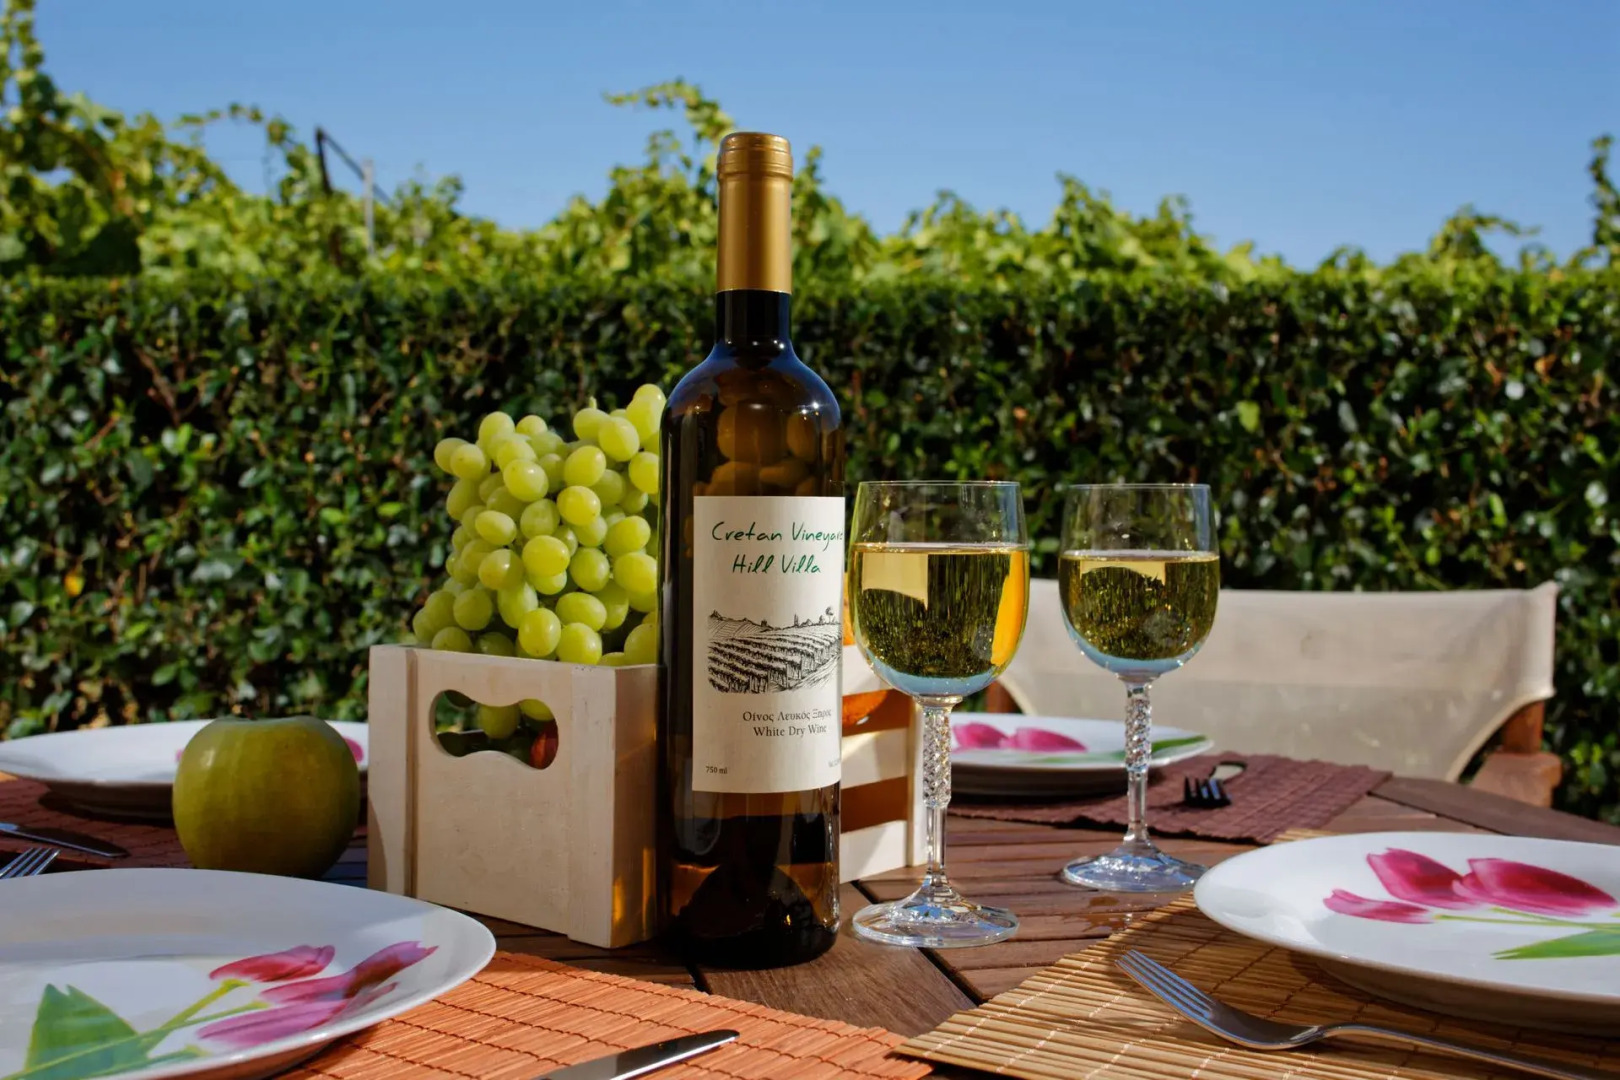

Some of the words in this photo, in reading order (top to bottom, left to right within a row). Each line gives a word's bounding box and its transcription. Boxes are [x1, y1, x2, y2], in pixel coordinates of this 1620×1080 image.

[711, 521, 782, 541] Cretan
[732, 554, 775, 574] Hill
[781, 554, 821, 574] Villa
[753, 726, 785, 737] White
[788, 725, 805, 738] Dry
[808, 723, 827, 734] Wine
[705, 765, 718, 774] 750
[719, 766, 728, 775] ml
